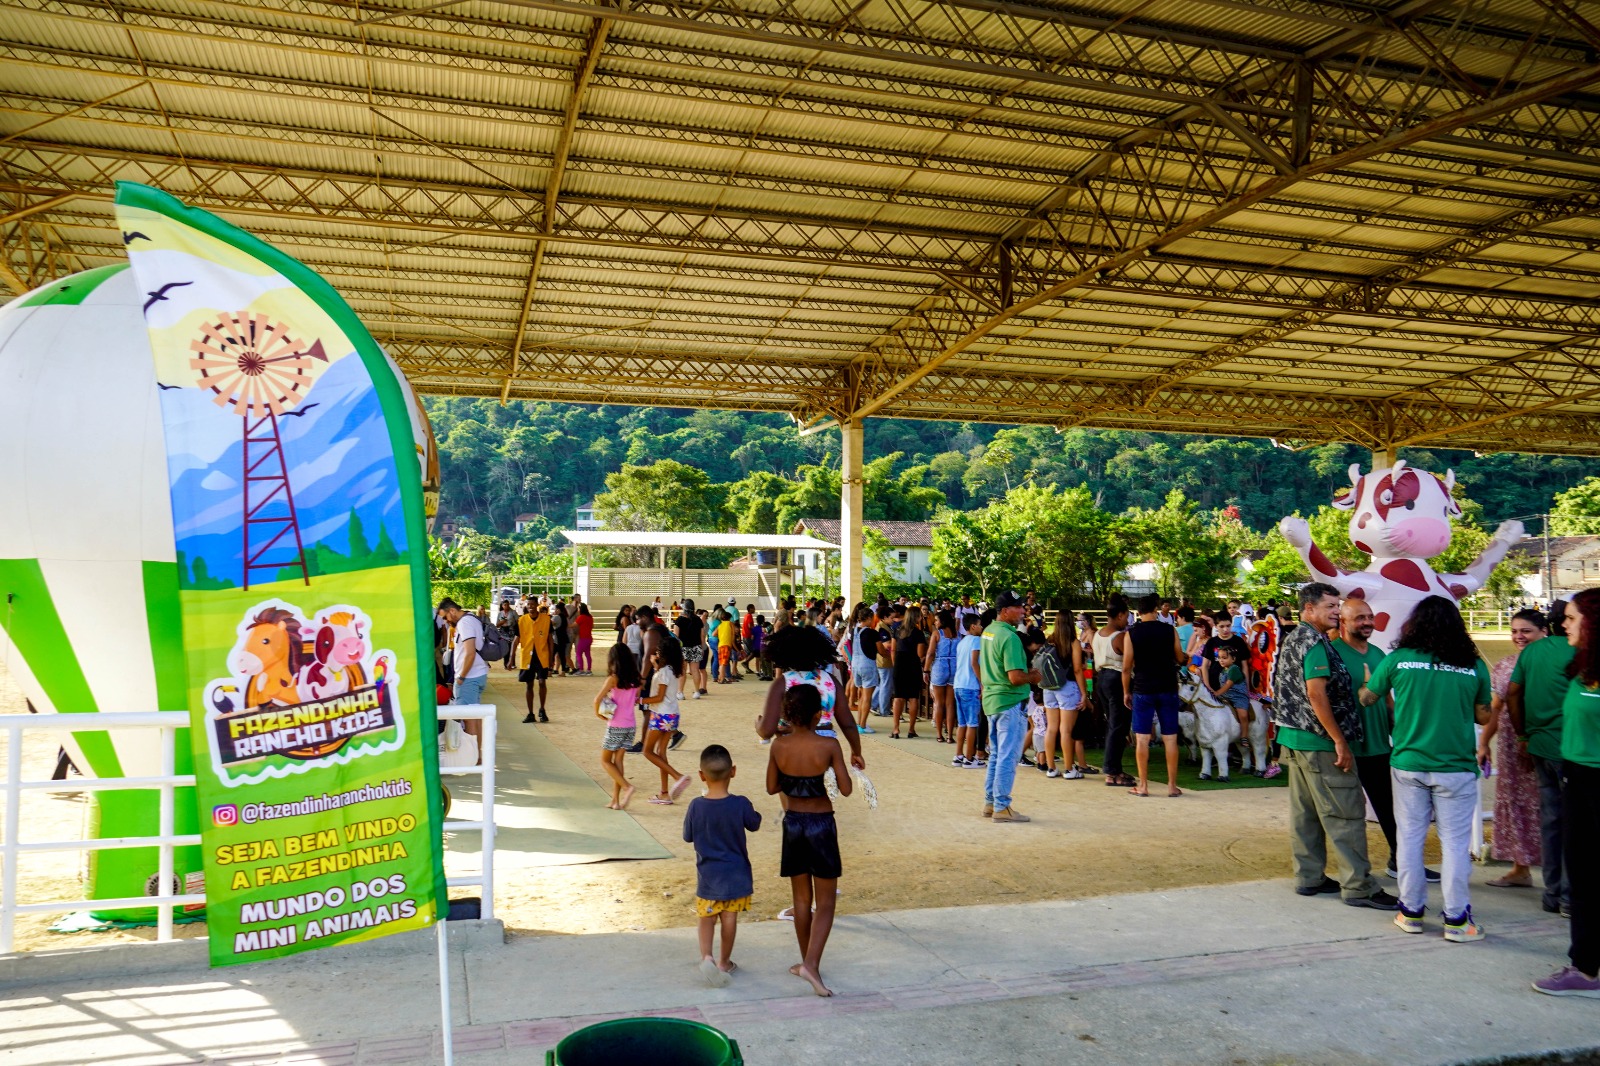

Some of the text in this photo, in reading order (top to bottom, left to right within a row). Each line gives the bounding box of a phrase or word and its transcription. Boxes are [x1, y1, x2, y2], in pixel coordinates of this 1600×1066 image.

[1397, 661, 1430, 670] EQUIPE
[229, 689, 380, 739] FAZENDINHA
[234, 708, 385, 758] RANCHO KIDS
[241, 778, 412, 824] @fazendinharanchokids
[216, 813, 416, 865] SEJA BEM VINDO
[231, 870, 251, 890] A
[256, 841, 408, 887] FAZENDINHA
[240, 873, 407, 925] MUNDO DOS
[234, 899, 417, 954] MINI ANIMAIS
